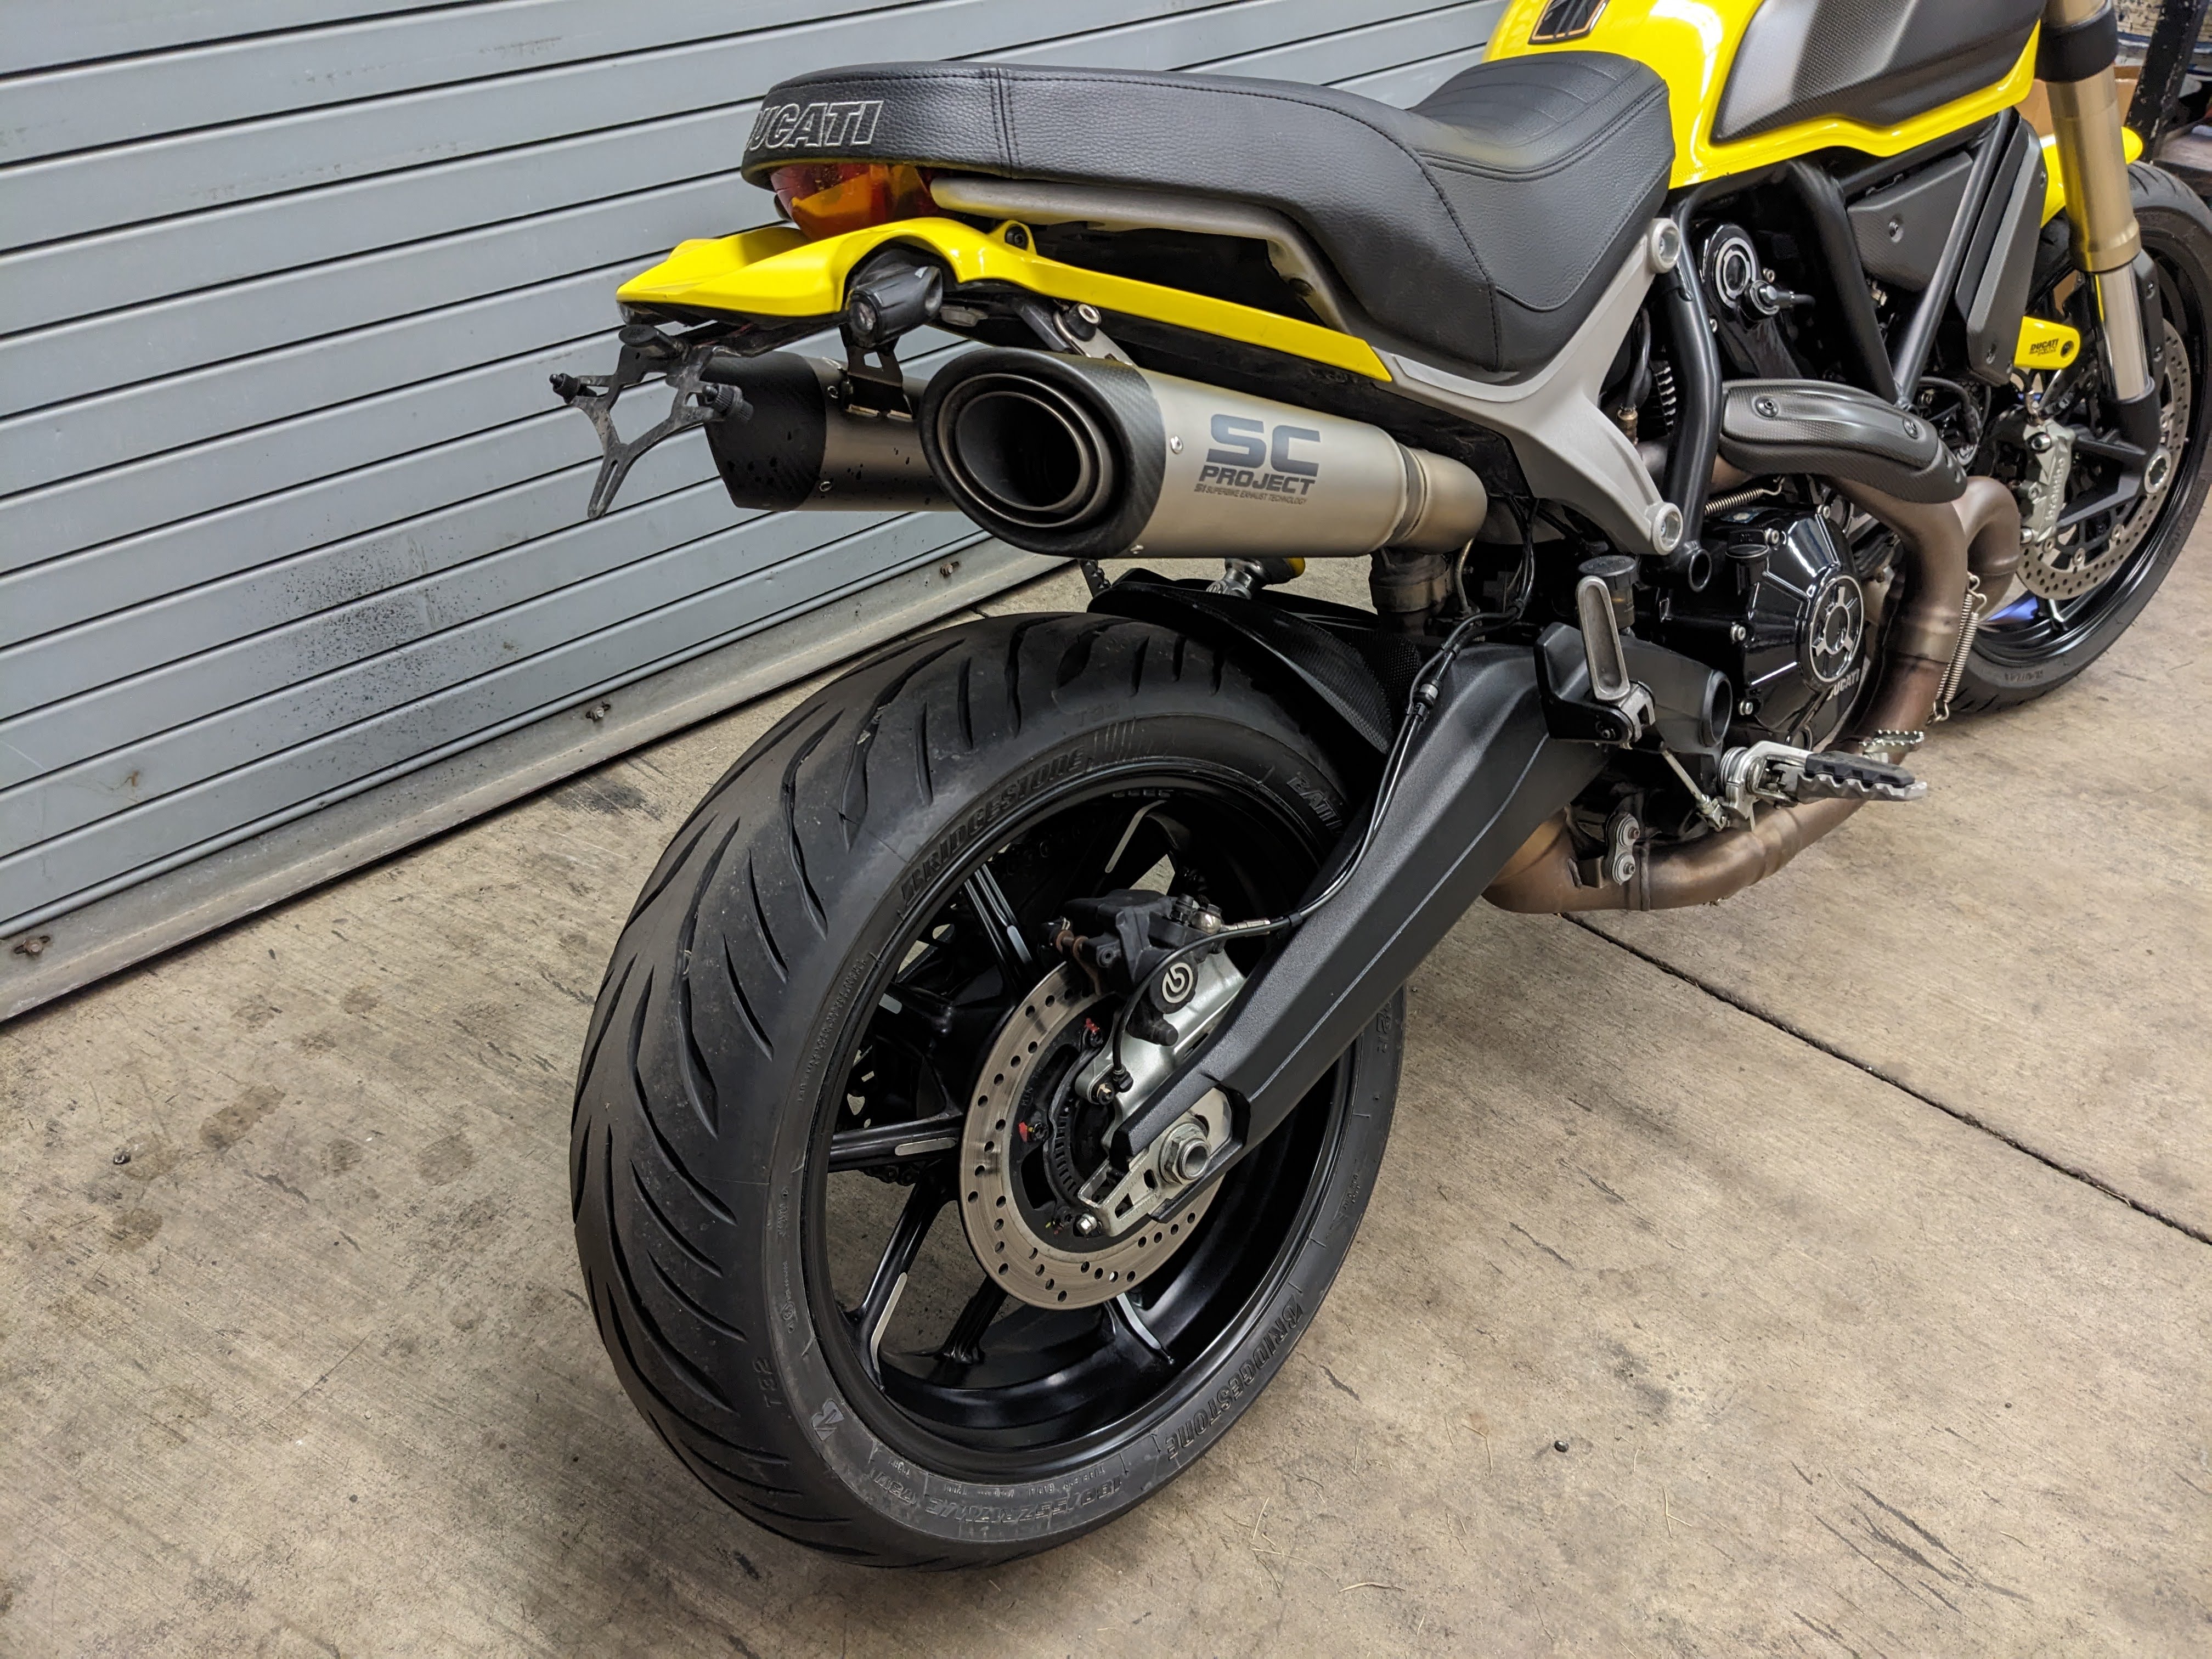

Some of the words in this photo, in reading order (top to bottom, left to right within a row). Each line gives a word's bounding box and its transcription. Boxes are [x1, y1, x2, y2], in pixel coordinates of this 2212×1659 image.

[746, 100, 883, 151] UCATI
[2030, 338, 2059, 351] DUCATI
[1206, 414, 1321, 477] SC
[1198, 465, 1315, 495] PROJECT
[1239, 490, 1267, 501] EXHAUST
[1268, 494, 1308, 505] TECHNOLOGY
[901, 745, 1085, 904] BRIDGESTONE
[1165, 1295, 1304, 1461] BRIDGESTONE
